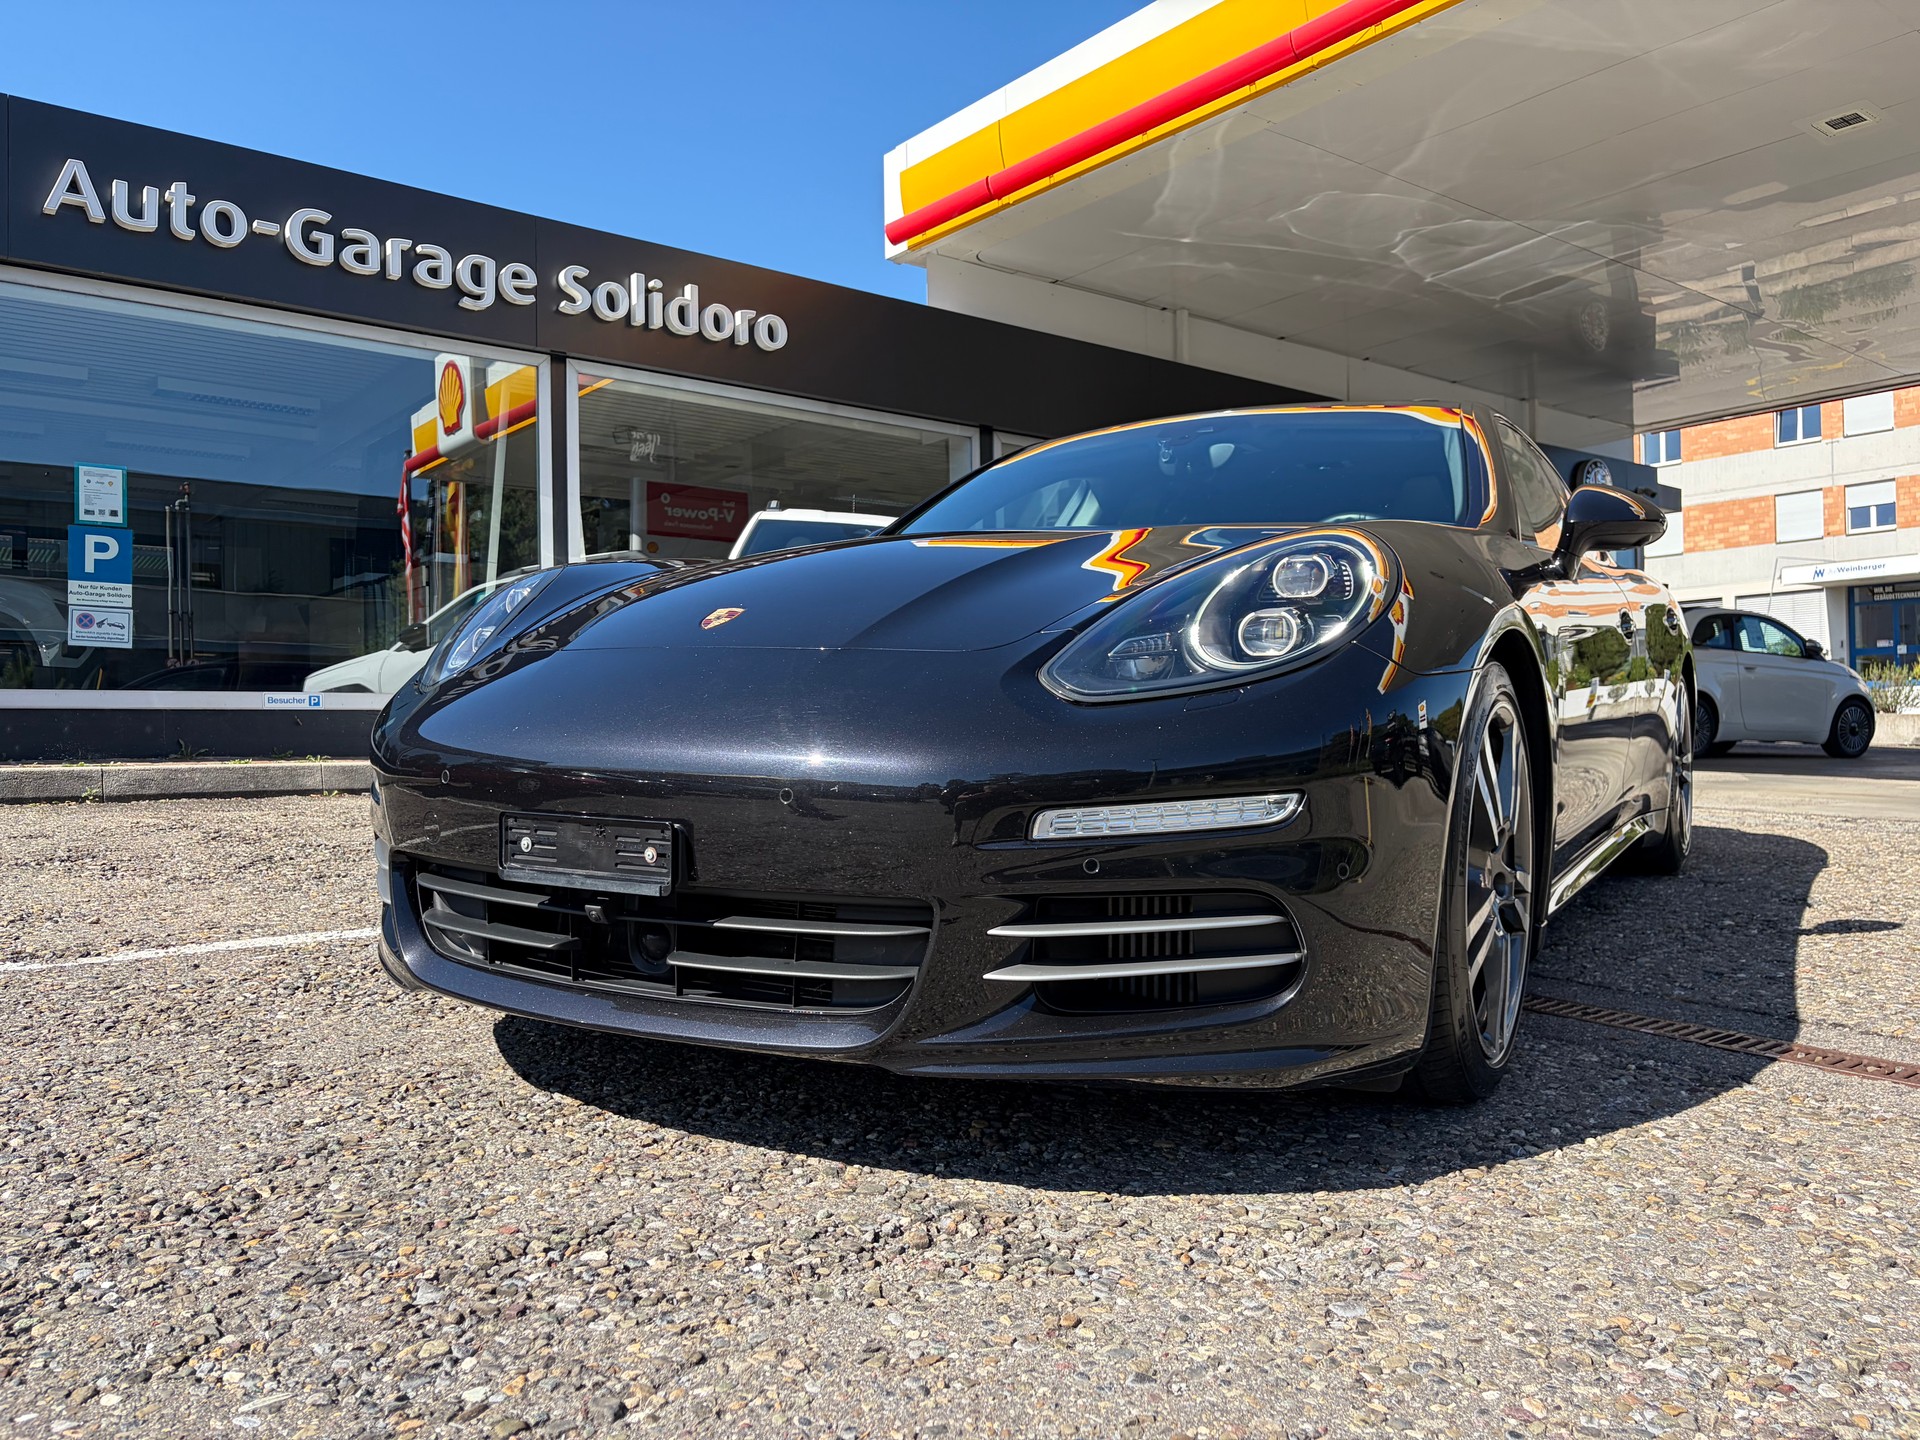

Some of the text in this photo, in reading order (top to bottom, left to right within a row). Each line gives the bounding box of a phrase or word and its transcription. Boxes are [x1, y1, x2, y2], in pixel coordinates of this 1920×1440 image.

[43, 158, 789, 352] Auto-Garage Solidoro
[84, 533, 120, 574] P
[1836, 563, 1886, 573] Weinberger
[69, 590, 106, 598] Auto-Garage
[267, 696, 306, 704] Besucher
